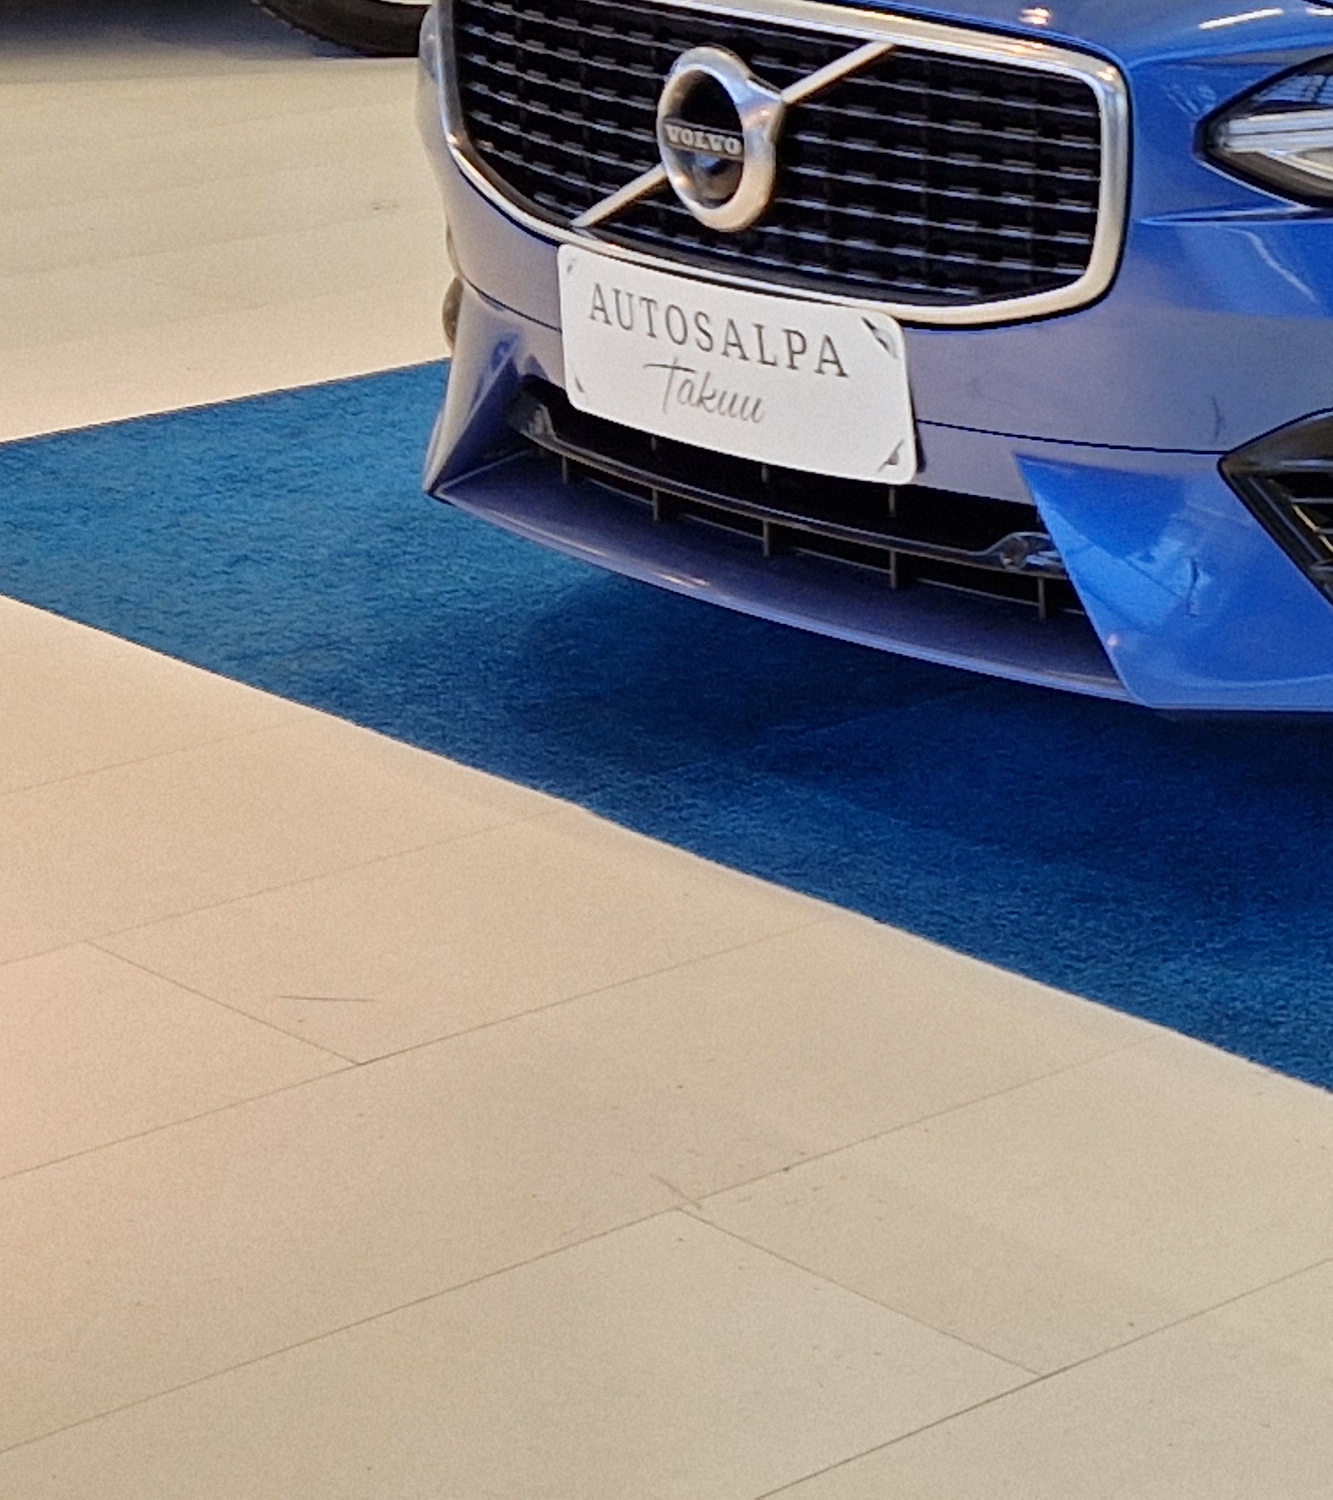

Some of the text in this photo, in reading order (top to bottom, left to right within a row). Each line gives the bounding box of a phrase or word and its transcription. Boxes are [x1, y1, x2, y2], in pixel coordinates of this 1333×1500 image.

[663, 123, 743, 156] VOLVO
[588, 282, 849, 378] AUTOSALPA
[643, 356, 765, 424] Takuu
